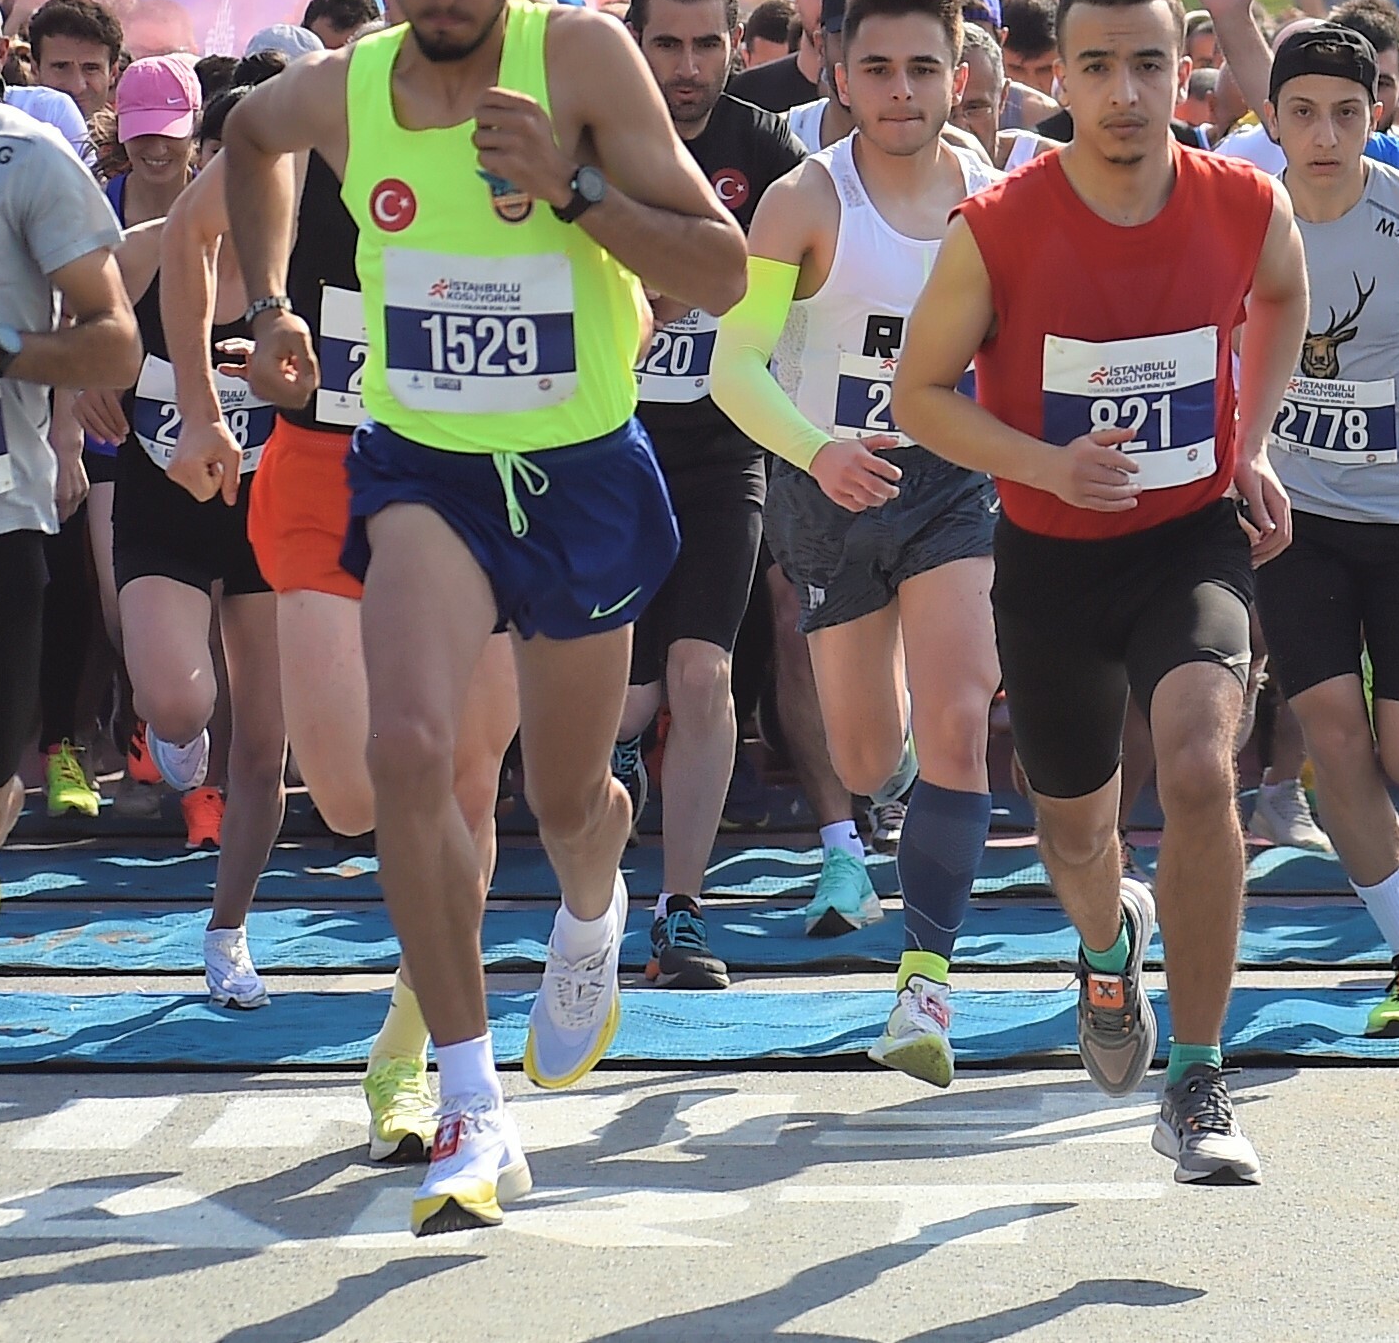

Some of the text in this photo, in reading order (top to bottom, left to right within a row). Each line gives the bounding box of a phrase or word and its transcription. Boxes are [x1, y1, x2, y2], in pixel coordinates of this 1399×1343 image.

[421, 314, 539, 375] 1529
[635, 332, 695, 375] 20
[1109, 360, 1177, 376] İSTANBULU
[1298, 381, 1355, 392] İSTANBULU
[1090, 393, 1171, 451] 821
[1279, 404, 1369, 450] 2778
